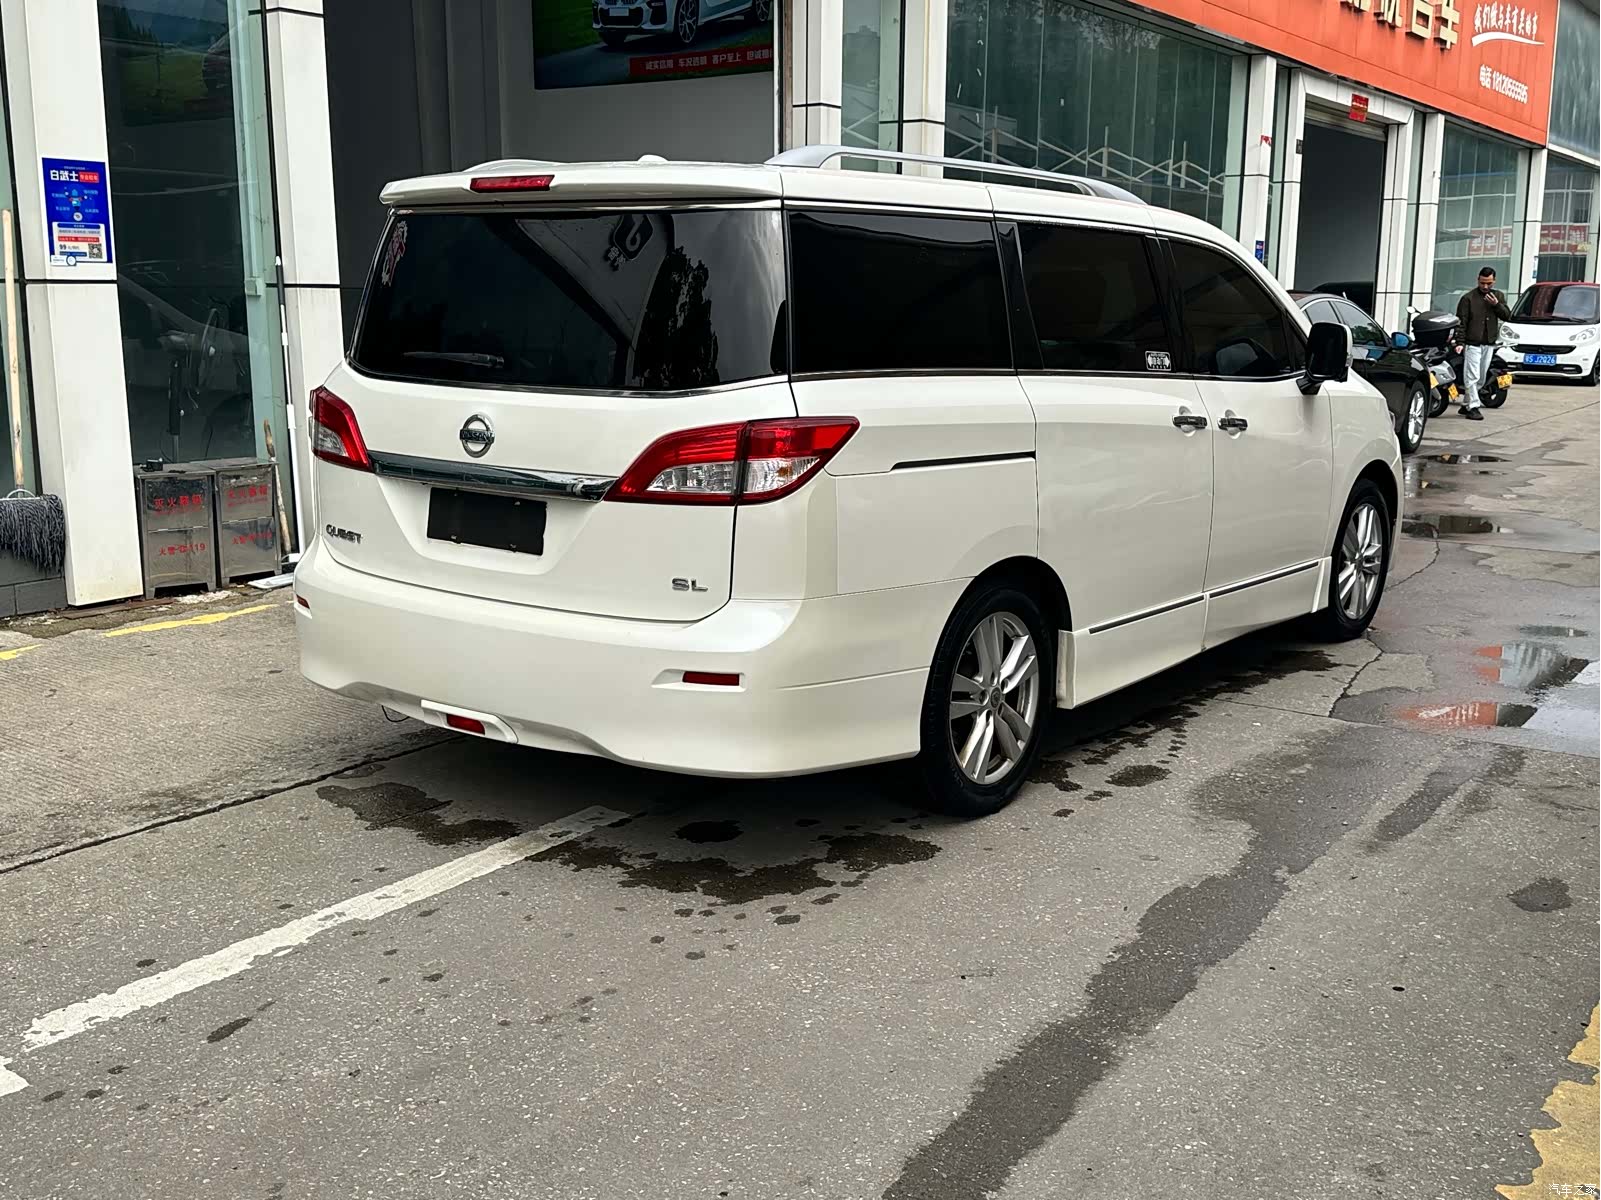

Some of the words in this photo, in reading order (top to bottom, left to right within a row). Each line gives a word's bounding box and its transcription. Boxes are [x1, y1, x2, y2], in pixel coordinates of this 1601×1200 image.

[712, 52, 741, 65] 客户至上
[1479, 64, 1492, 89] 电话
[50, 169, 79, 182] 白武士
[461, 430, 493, 443] NISSAN
[326, 523, 362, 545] QUEST
[671, 577, 709, 592] SL
